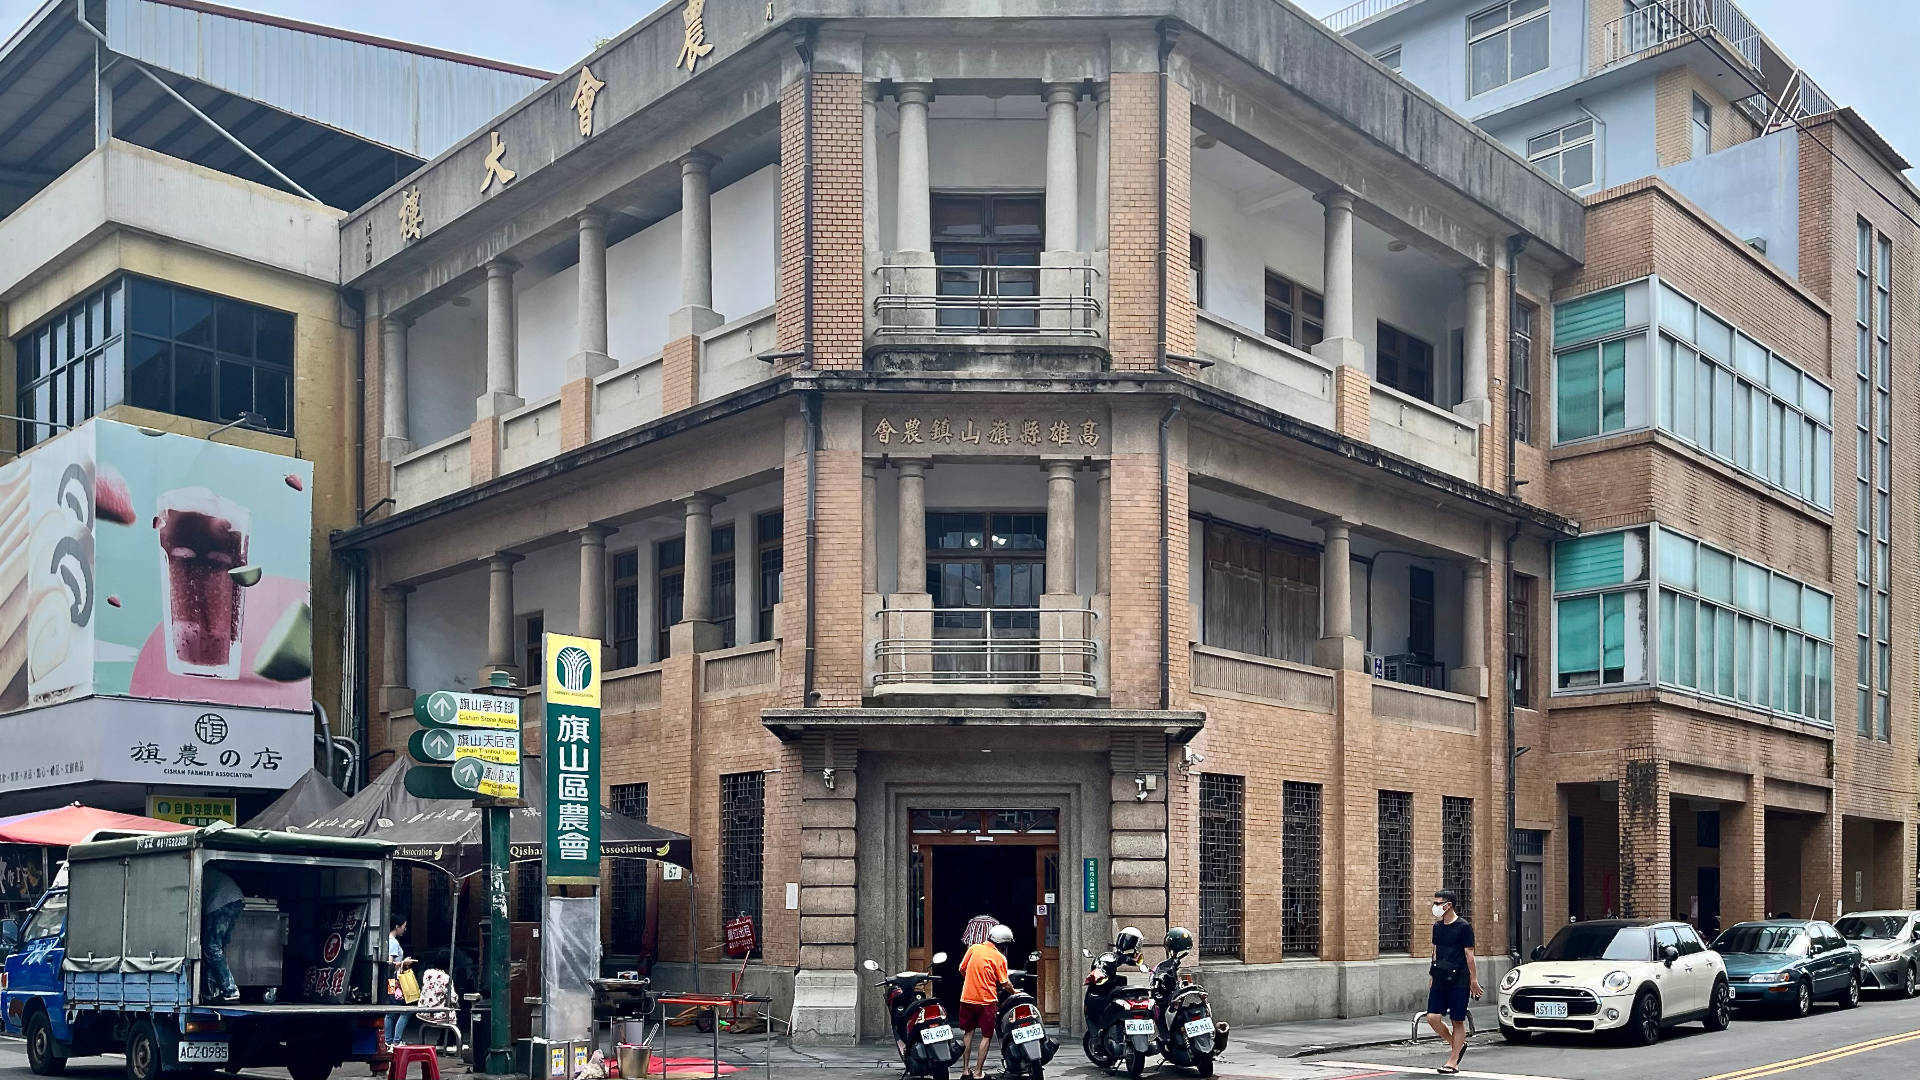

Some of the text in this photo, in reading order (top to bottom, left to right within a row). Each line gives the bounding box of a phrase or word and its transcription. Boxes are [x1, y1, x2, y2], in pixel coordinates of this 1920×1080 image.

[459, 714, 480, 722] Cishan
[457, 734, 516, 748] 旗山天后宮
[130, 740, 283, 771] 旗農の店
[164, 768, 185, 776] CISHAN
[216, 771, 253, 779] ASSOCIATION
[556, 715, 591, 861] 旗山區農會
[180, 1046, 228, 1059] ACZ-0985
